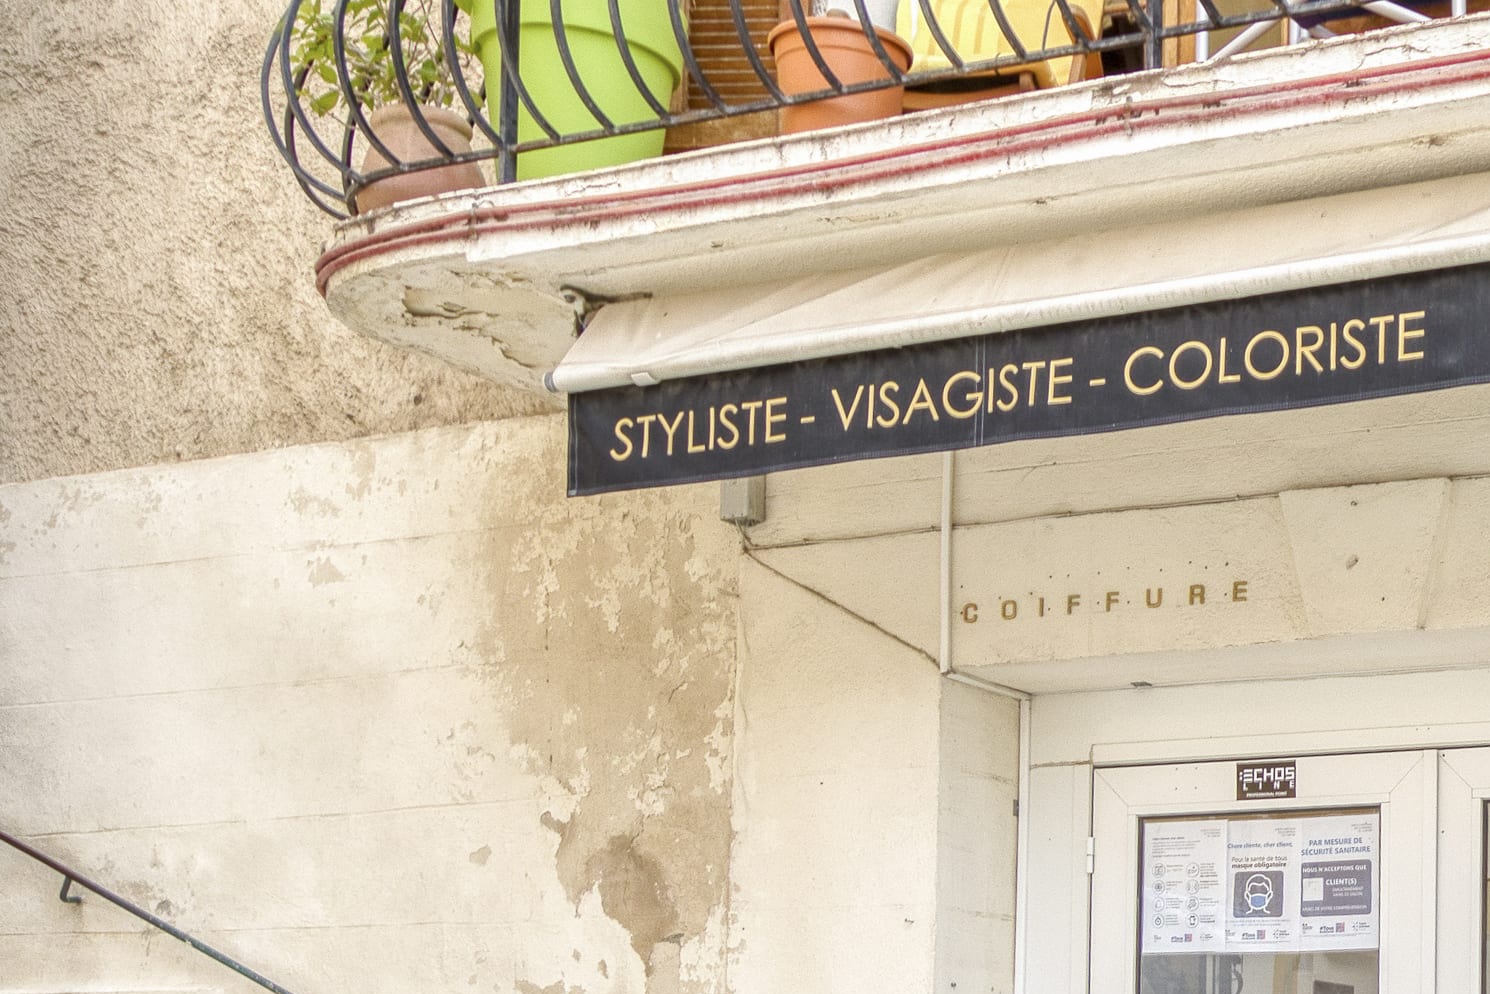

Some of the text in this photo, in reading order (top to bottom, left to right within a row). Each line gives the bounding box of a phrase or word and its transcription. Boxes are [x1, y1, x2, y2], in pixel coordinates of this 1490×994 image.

[609, 397, 786, 461] STYLISTE
[832, 357, 1074, 432] VISAGISTE
[1123, 310, 1425, 396] COLORISTE
[960, 579, 1250, 626] COIFFURE
[1335, 846, 1371, 854] SANITAIRE
[1326, 878, 1357, 886] CLIENT(S)
